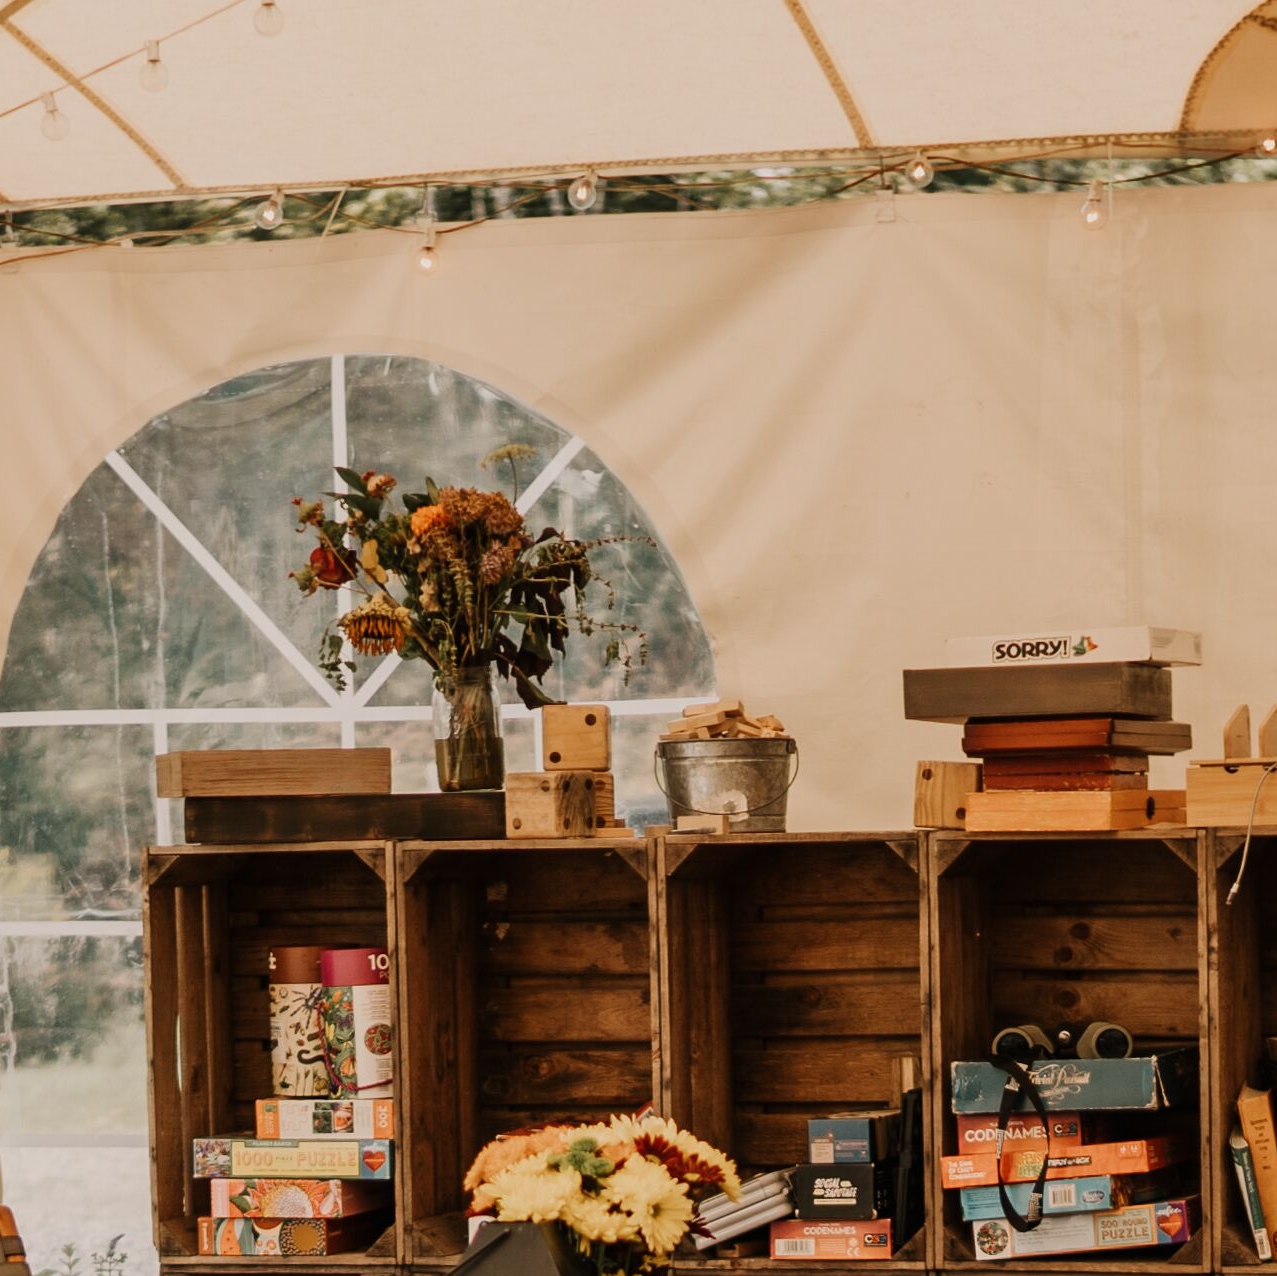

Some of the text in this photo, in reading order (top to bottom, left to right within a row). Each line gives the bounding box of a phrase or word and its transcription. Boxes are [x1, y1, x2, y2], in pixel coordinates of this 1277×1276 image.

[996, 640, 1067, 659] SORRY!
[964, 1126, 1050, 1142] CODNAMES
[236, 1151, 274, 1166] 1000
[297, 1151, 356, 1167] PUZZLE
[804, 1226, 856, 1236] CODENAMES
[1102, 1227, 1149, 1240] PUZZLE
